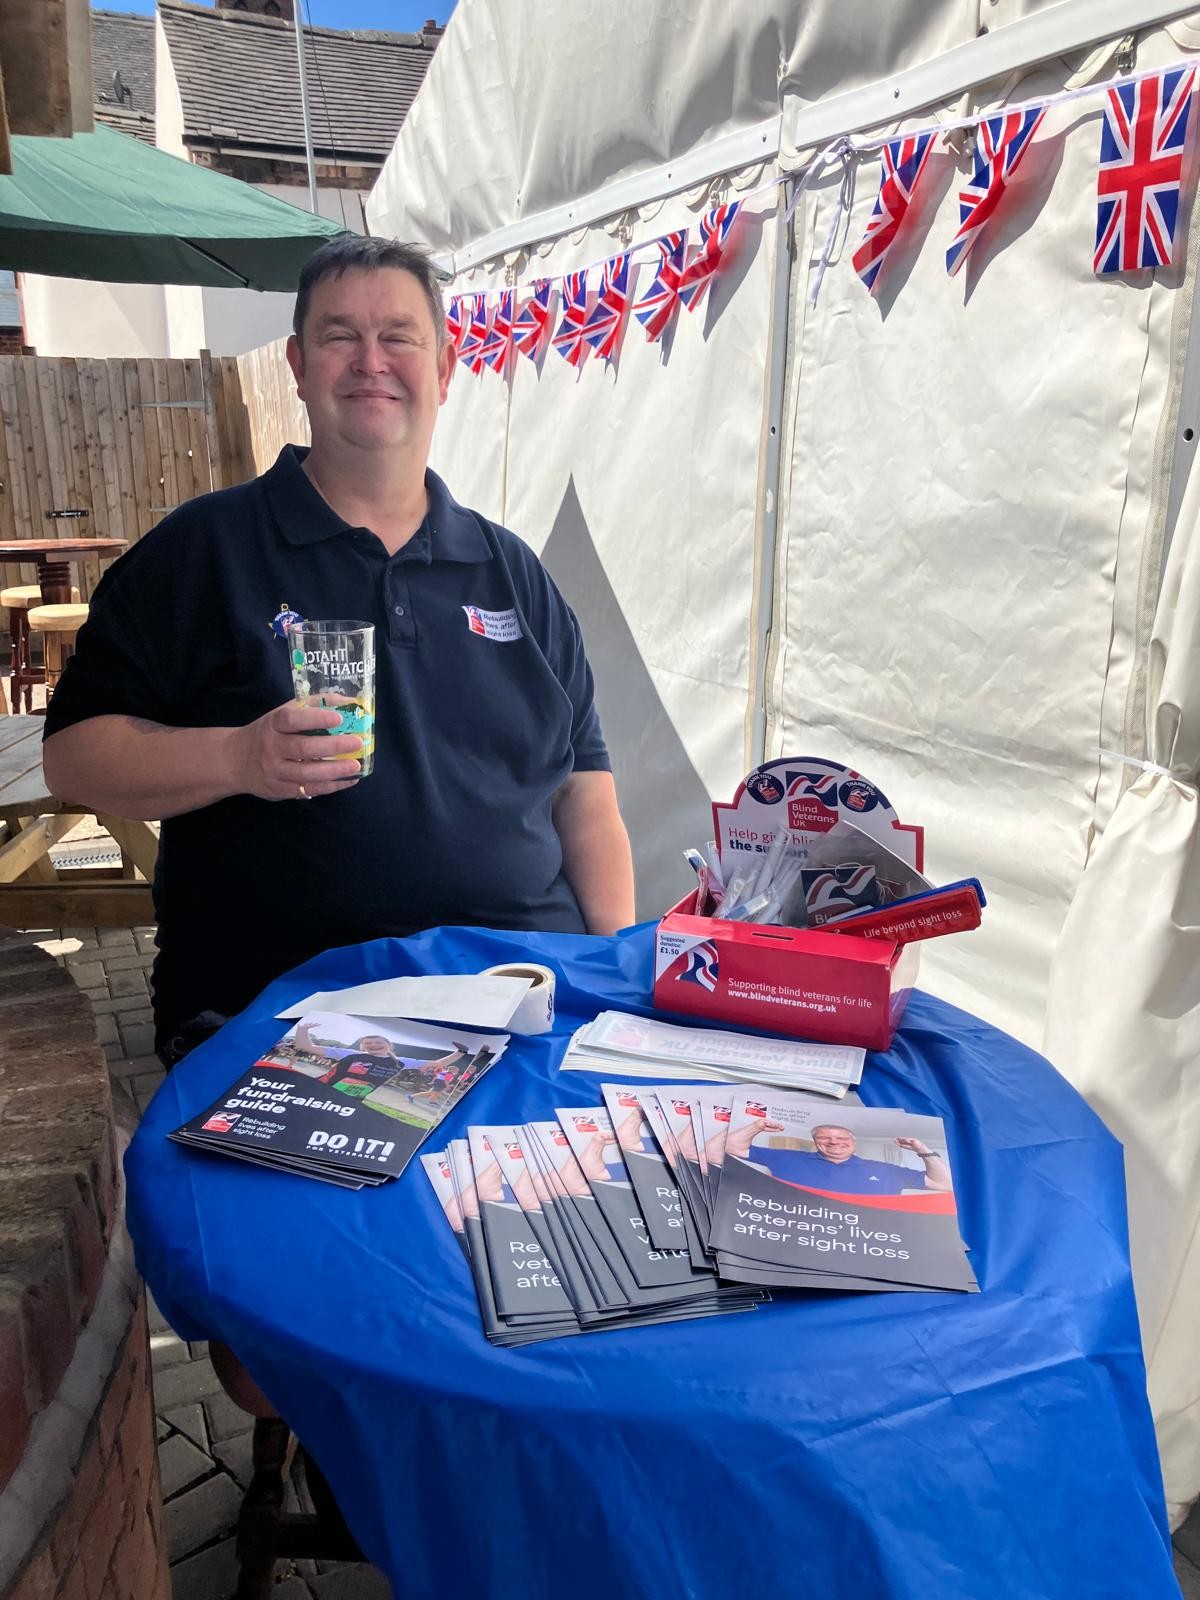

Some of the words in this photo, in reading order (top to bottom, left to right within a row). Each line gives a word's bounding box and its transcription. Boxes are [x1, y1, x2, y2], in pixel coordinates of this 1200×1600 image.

[792, 803, 818, 814] Blind
[792, 812, 835, 824] Veterans
[793, 820, 807, 828] UK
[728, 827, 758, 841] Help
[729, 839, 752, 851] the
[863, 927, 881, 938] Life
[882, 918, 916, 934] beyond
[918, 912, 942, 928] sight
[943, 909, 963, 920] loss
[660, 947, 680, 955] £1.50
[728, 977, 777, 994] Supporting
[778, 985, 801, 997] blind
[802, 990, 841, 1003] veterans
[843, 995, 856, 1005] for
[858, 997, 872, 1008] life
[727, 989, 837, 1013] www.blindveterans.org.uk
[250, 1077, 296, 1091] Your
[224, 1098, 286, 1114] guide
[237, 1086, 356, 1117] fundraising
[237, 1122, 256, 1130] lives
[257, 1126, 279, 1135] after
[242, 1116, 286, 1131] Rebuilding
[232, 1128, 254, 1136] sight
[254, 1131, 271, 1139] loss
[308, 1131, 349, 1149] DO
[354, 1137, 396, 1162] IT!
[328, 1148, 376, 1160] VETERANS
[738, 1192, 859, 1225] Rebuilding
[733, 1223, 791, 1243] after
[797, 1235, 857, 1253] sight
[863, 1243, 910, 1260] loss
[849, 1226, 902, 1243] lives
[647, 1249, 691, 1261] afte
[516, 1272, 562, 1288] afte
